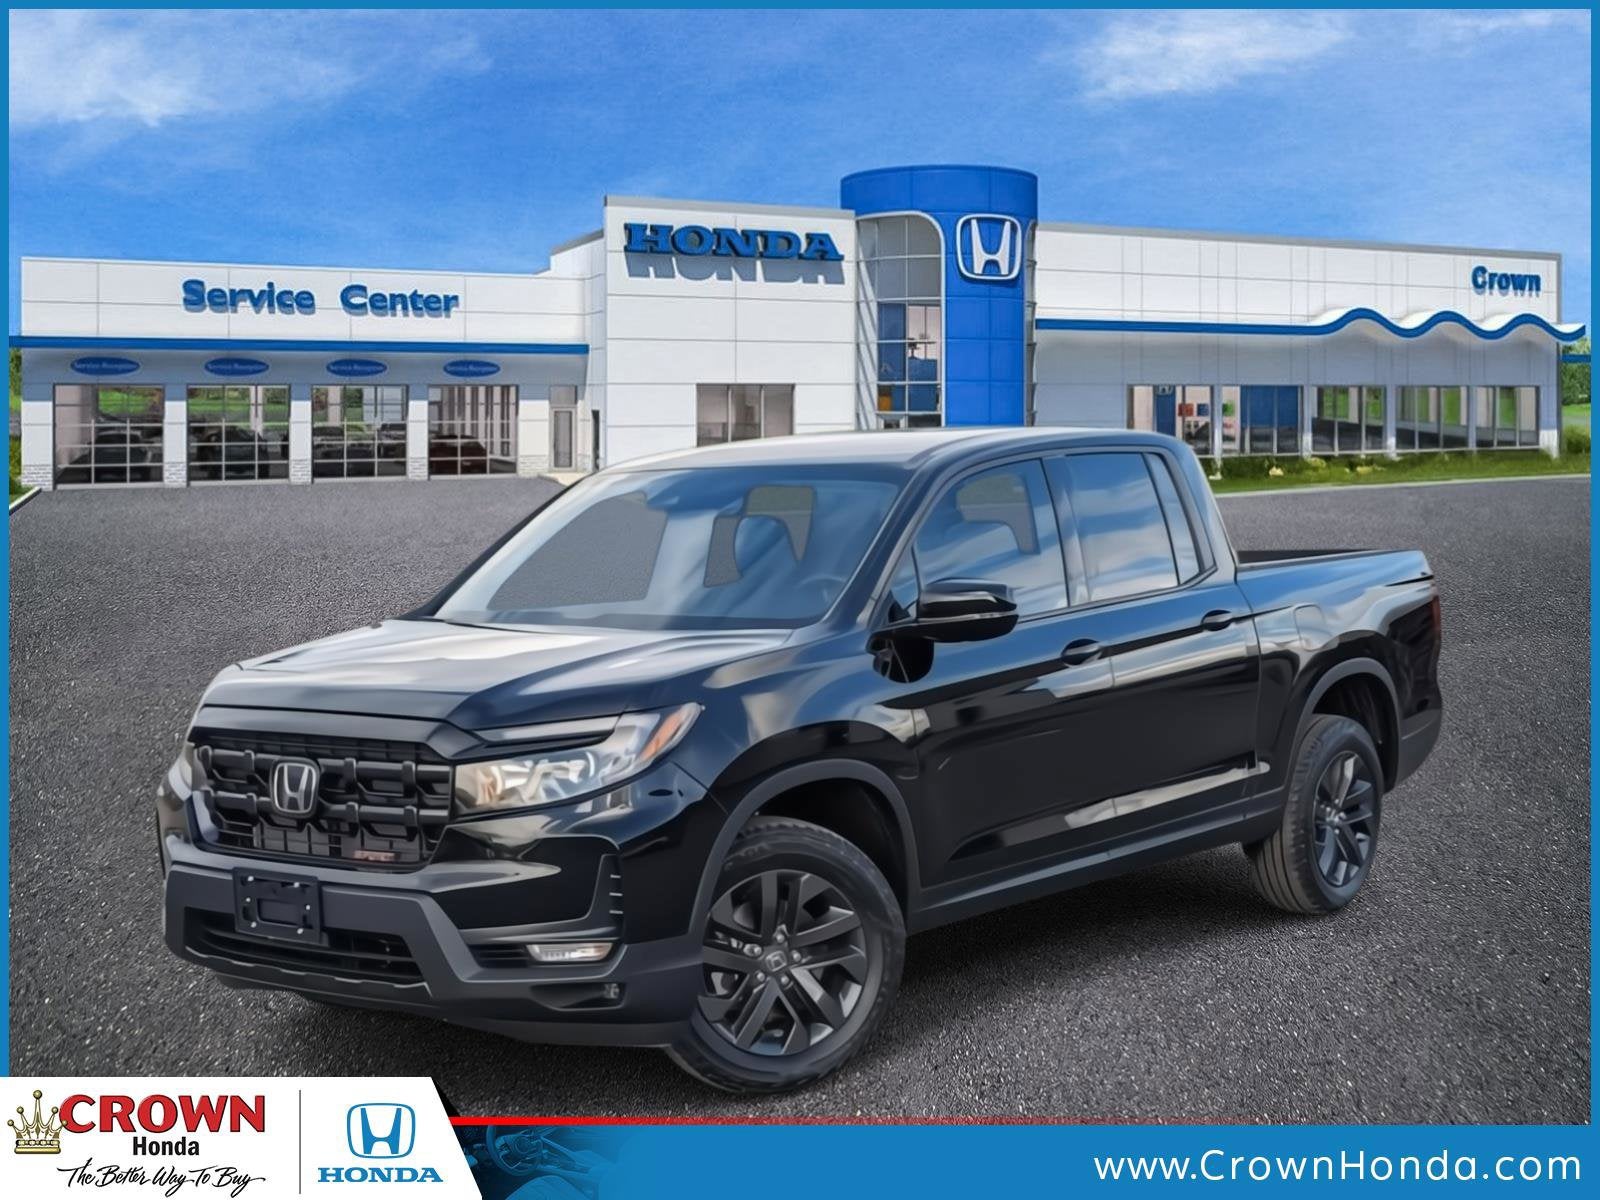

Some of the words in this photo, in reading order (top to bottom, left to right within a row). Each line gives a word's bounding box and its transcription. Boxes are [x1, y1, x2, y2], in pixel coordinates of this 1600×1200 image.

[624, 222, 844, 261] HONDA
[182, 279, 316, 312] Service
[340, 284, 460, 315] Center
[1471, 265, 1542, 293] Crown
